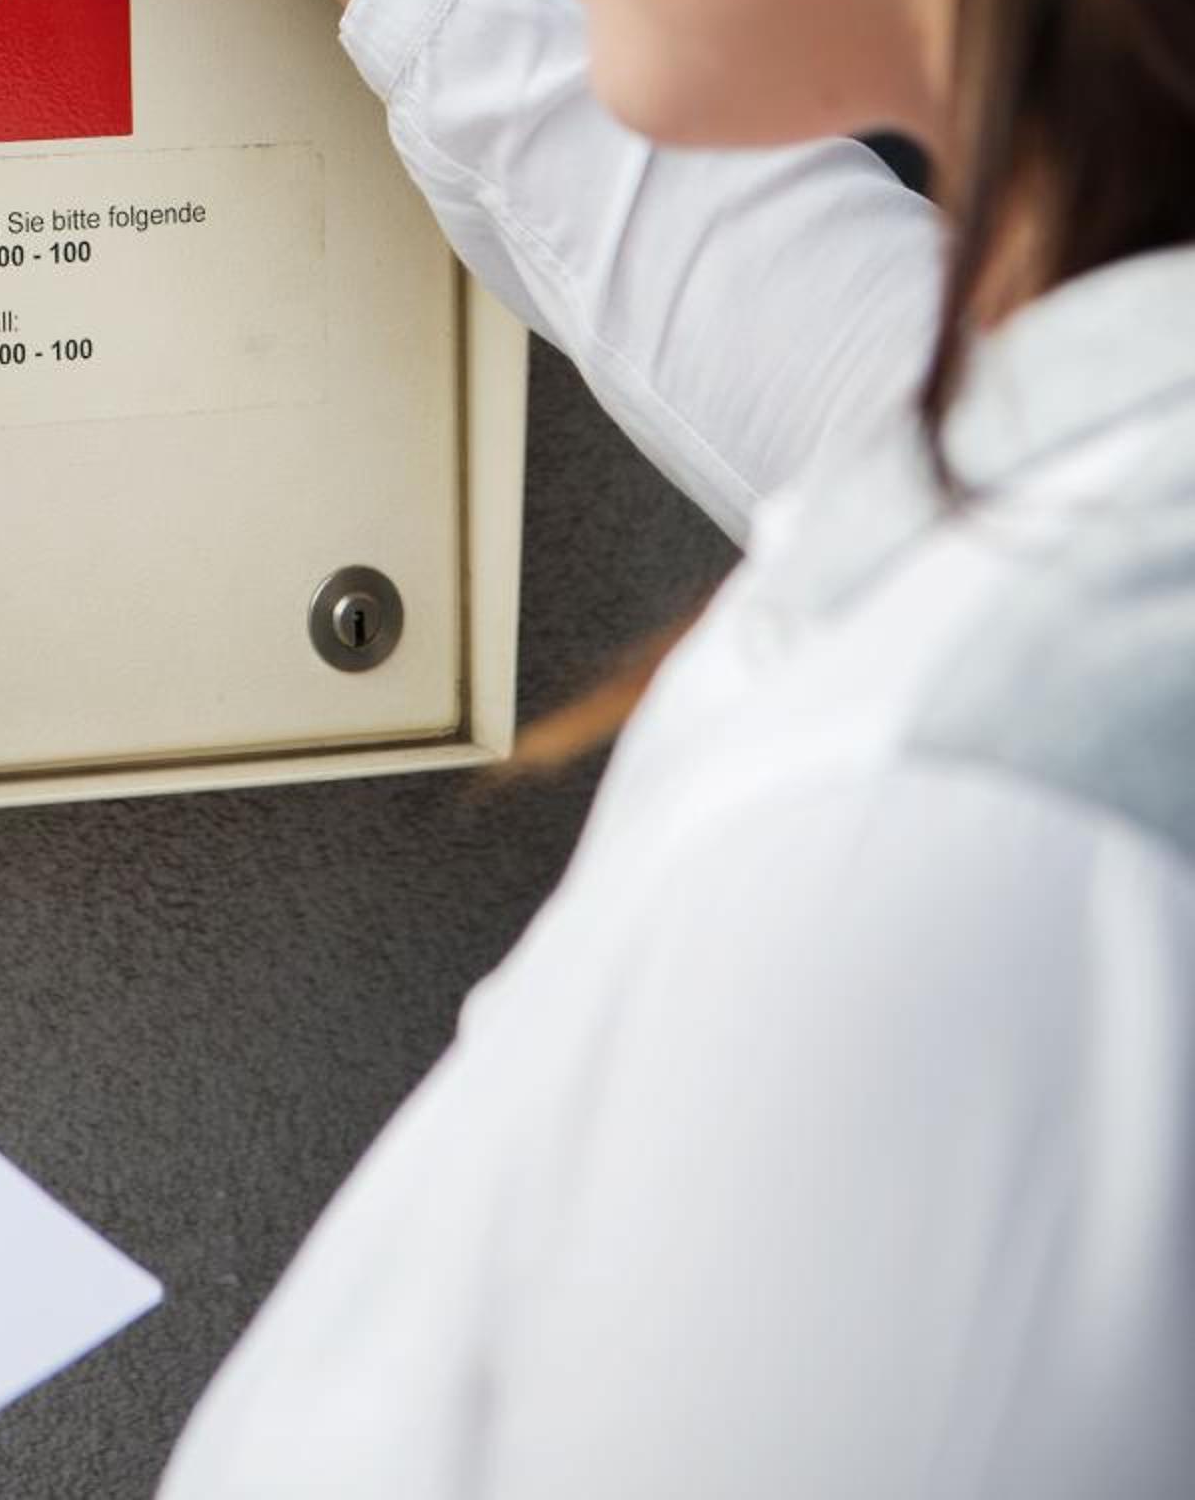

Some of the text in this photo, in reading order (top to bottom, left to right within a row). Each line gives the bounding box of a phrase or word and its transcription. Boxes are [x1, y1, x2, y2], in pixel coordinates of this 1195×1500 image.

[7, 211, 45, 234] Sie
[51, 208, 102, 232] bitte
[107, 201, 207, 233] folgende
[48, 240, 92, 265] 100
[50, 338, 94, 362] 100
